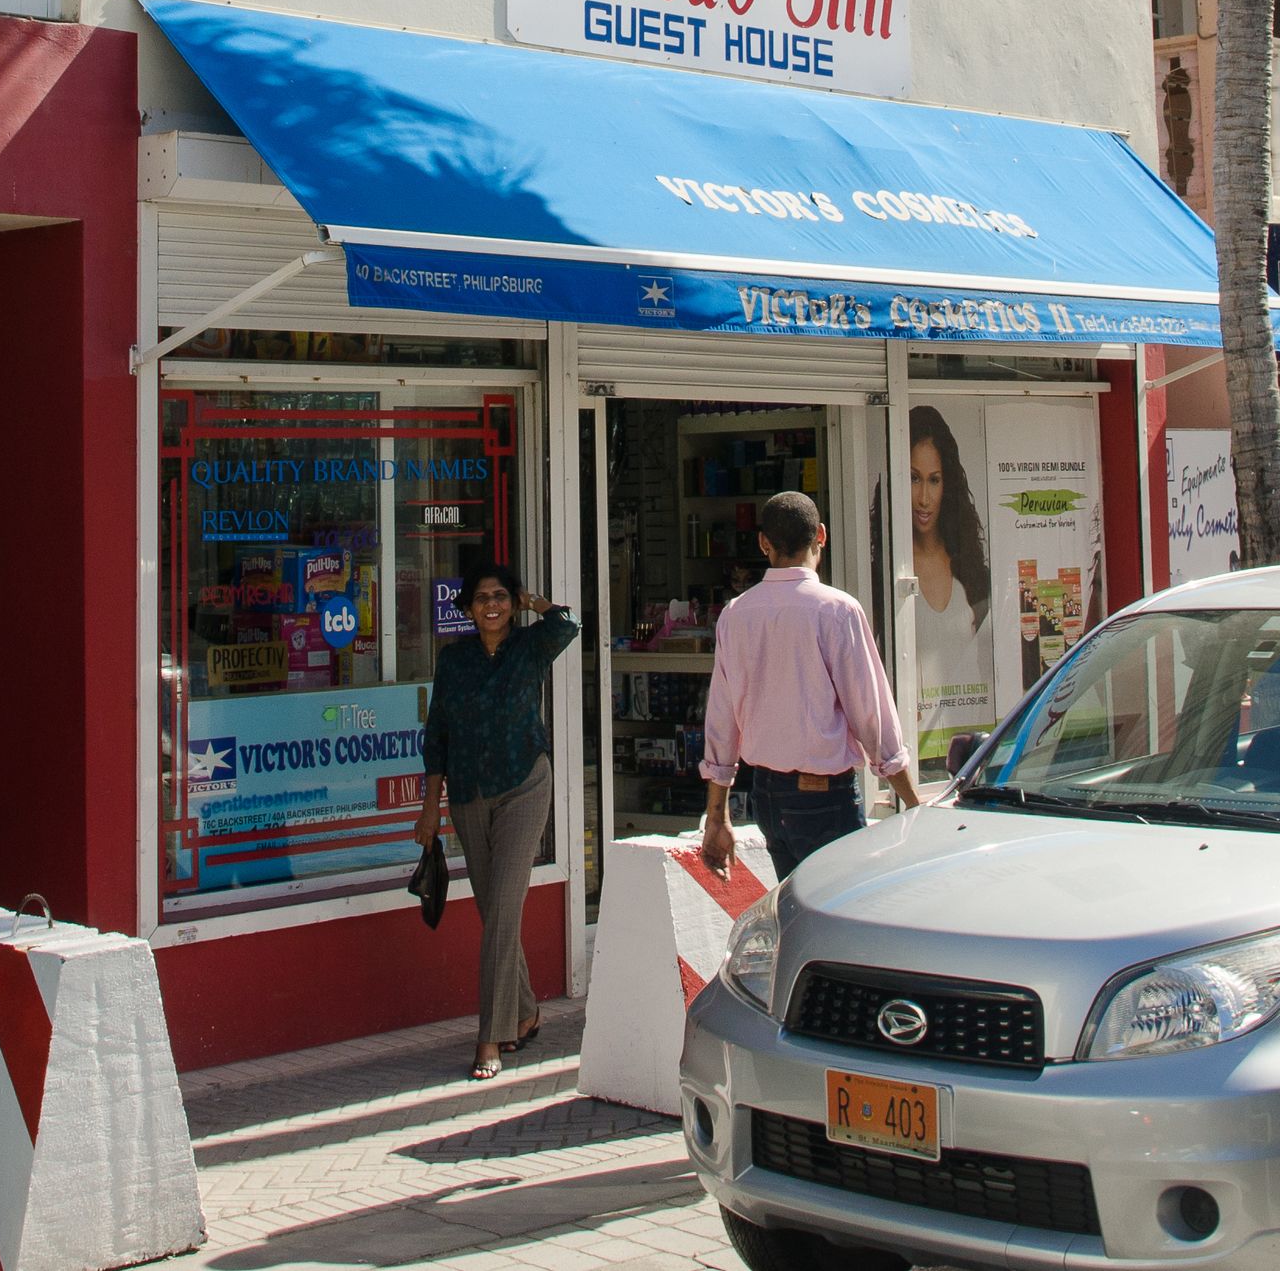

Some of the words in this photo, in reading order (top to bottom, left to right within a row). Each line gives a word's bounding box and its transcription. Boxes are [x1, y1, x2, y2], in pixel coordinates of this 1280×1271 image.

[584, 0, 707, 57] GUEST
[724, 23, 834, 78] HOUSE
[654, 174, 845, 224] VICTOR'S
[464, 274, 544, 295] PHILIPSBURG
[736, 284, 873, 330] VICTOR'S
[890, 295, 1041, 334] COSMETICS
[1047, 303, 1076, 335] II
[191, 458, 306, 491] QUALITY
[314, 458, 400, 482] BRAND
[406, 457, 490, 481] NAMES
[997, 462, 1017, 474] 100%
[1017, 461, 1041, 474] VIRGIN
[1041, 461, 1060, 473] REMI
[1060, 461, 1087, 473] BUNDLE
[1181, 453, 1227, 504] Equipments
[1020, 491, 1069, 513] Peruvian
[201, 509, 290, 533] REVLON
[1014, 517, 1048, 531] Customized
[1196, 503, 1239, 539] Cosmeti
[436, 583, 462, 603] Da
[324, 605, 357, 633] tcb
[437, 605, 465, 622] Love
[354, 638, 377, 652] HUGG
[212, 646, 286, 673] PROFECTIV
[939, 698, 958, 709] FREE
[957, 696, 989, 707] CLOSURE
[941, 684, 962, 697] MULTI
[963, 682, 989, 696] LENGTH
[339, 704, 377, 730] T-Tree
[238, 736, 331, 776] VICTOR'S
[334, 728, 426, 765] COSMETIC
[186, 780, 238, 795] VICTOR'S
[217, 814, 268, 829] BACKSTREET
[271, 811, 286, 823] 40A
[336, 801, 378, 815] PHILIPSBUR
[837, 1086, 851, 1128] R
[884, 1095, 926, 1142] 403
